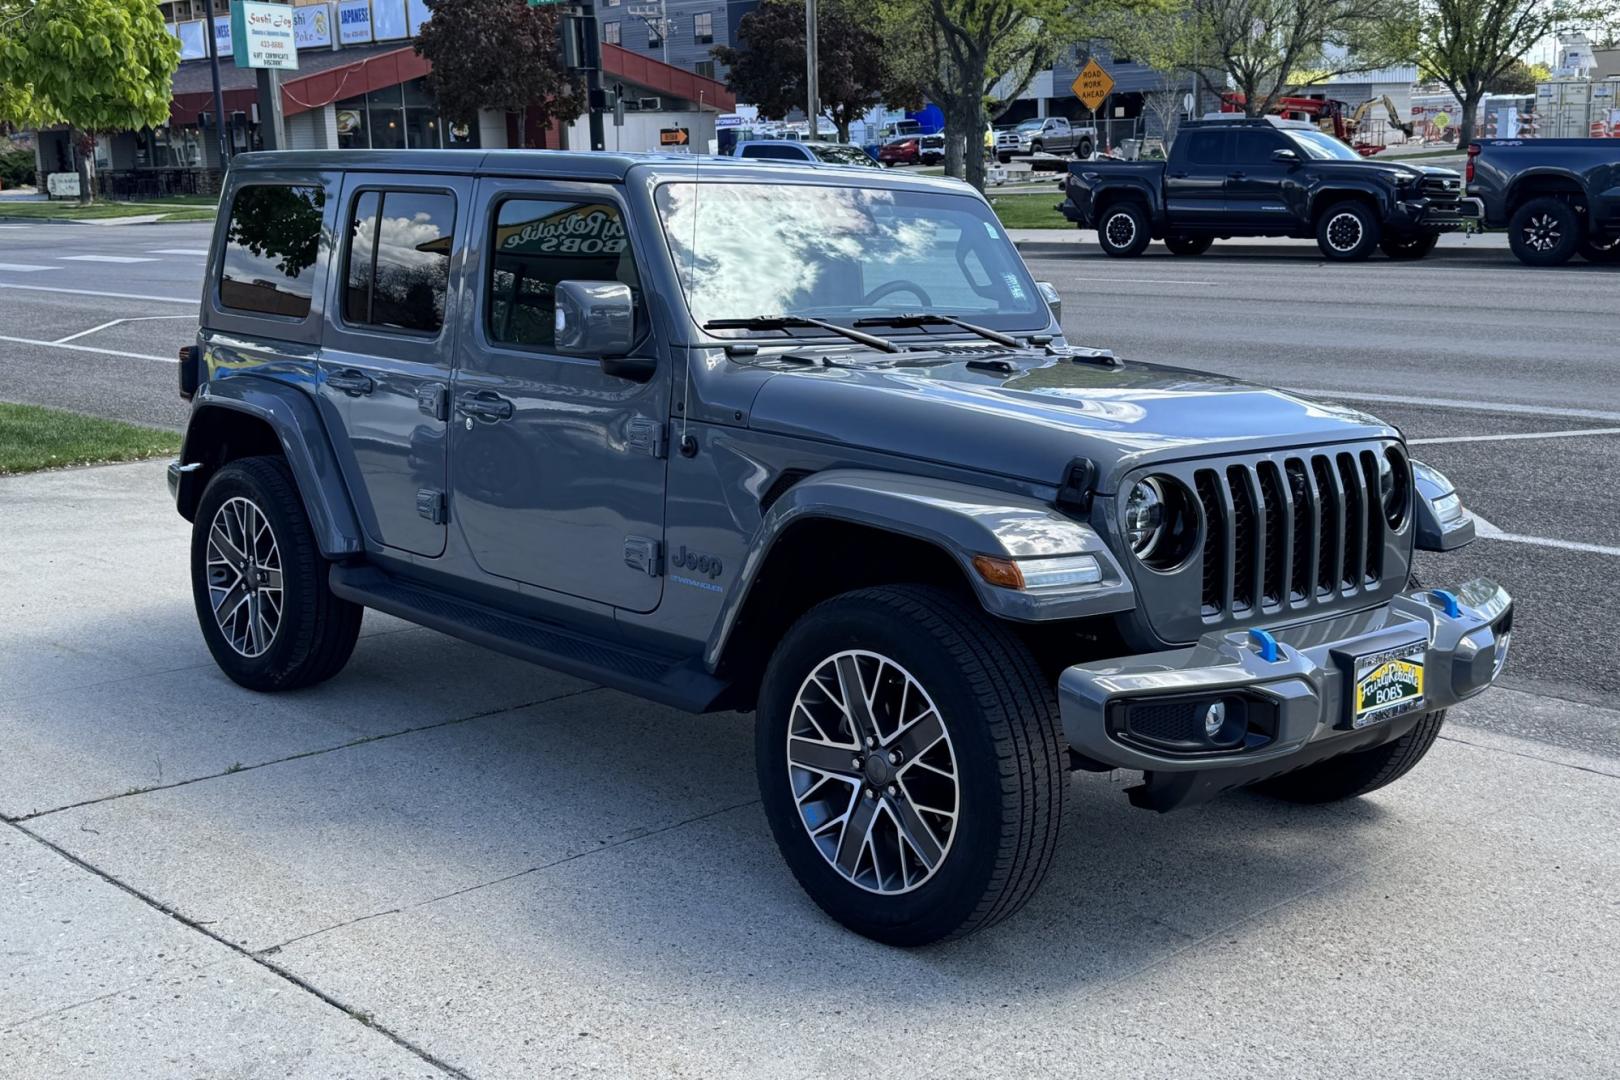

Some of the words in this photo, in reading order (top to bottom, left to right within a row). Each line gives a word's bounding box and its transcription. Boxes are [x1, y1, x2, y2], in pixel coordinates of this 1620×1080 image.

[248, 12, 272, 25] Sushi
[273, 15, 292, 28] Joy
[293, 12, 305, 25] shi
[341, 7, 369, 24] JAPANESE
[1082, 70, 1102, 79] ROAD
[1083, 80, 1102, 89] WORK
[1082, 90, 1105, 99] AHEAD
[671, 545, 723, 580] Jeep
[1361, 668, 1391, 701] Fairly
[1388, 662, 1419, 688] Reliable
[1376, 683, 1403, 704] BOB'S
